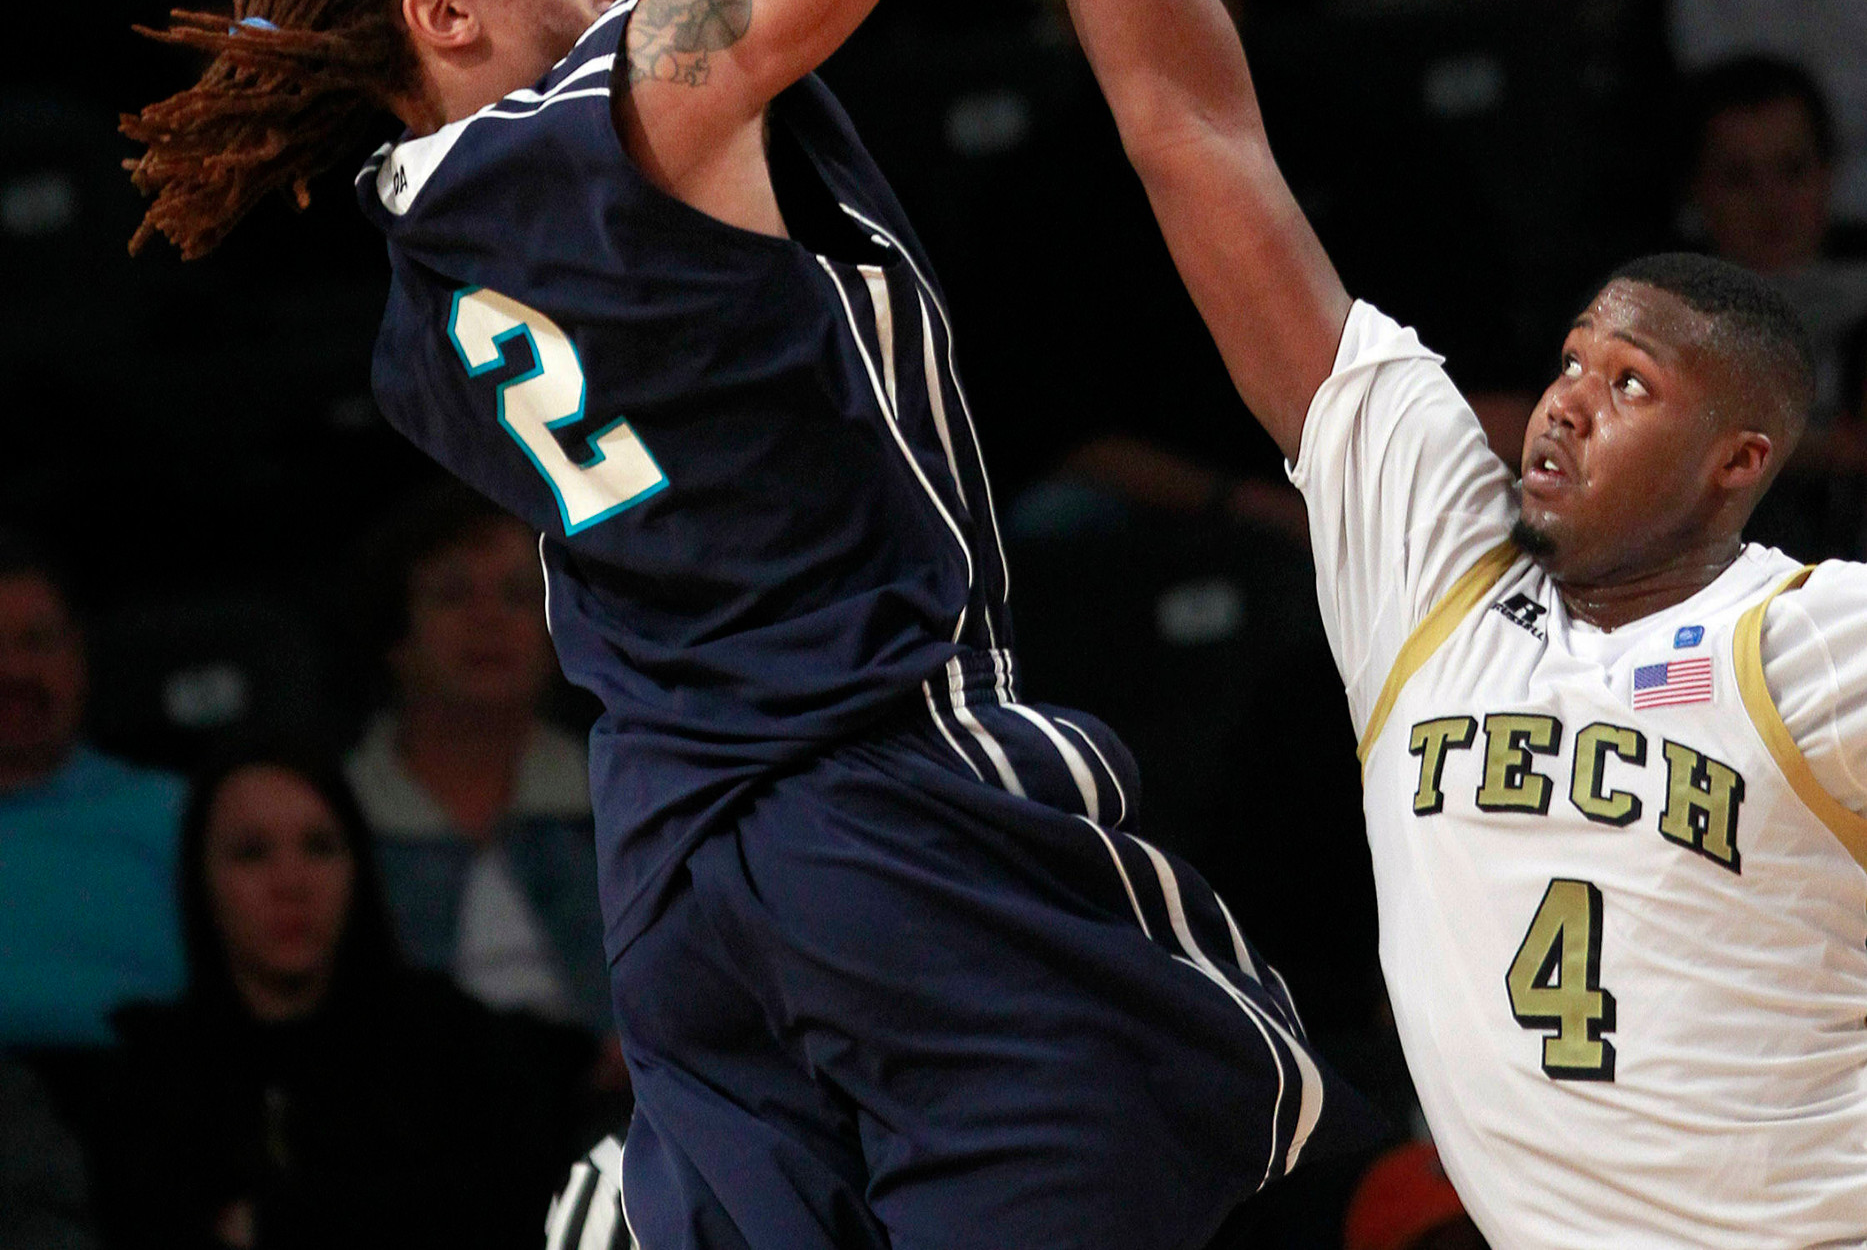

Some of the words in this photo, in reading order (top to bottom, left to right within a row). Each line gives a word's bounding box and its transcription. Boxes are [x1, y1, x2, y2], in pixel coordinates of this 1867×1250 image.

[447, 284, 671, 538] 2
[1409, 712, 1746, 876] TECH
[1505, 877, 1617, 1083] 4
